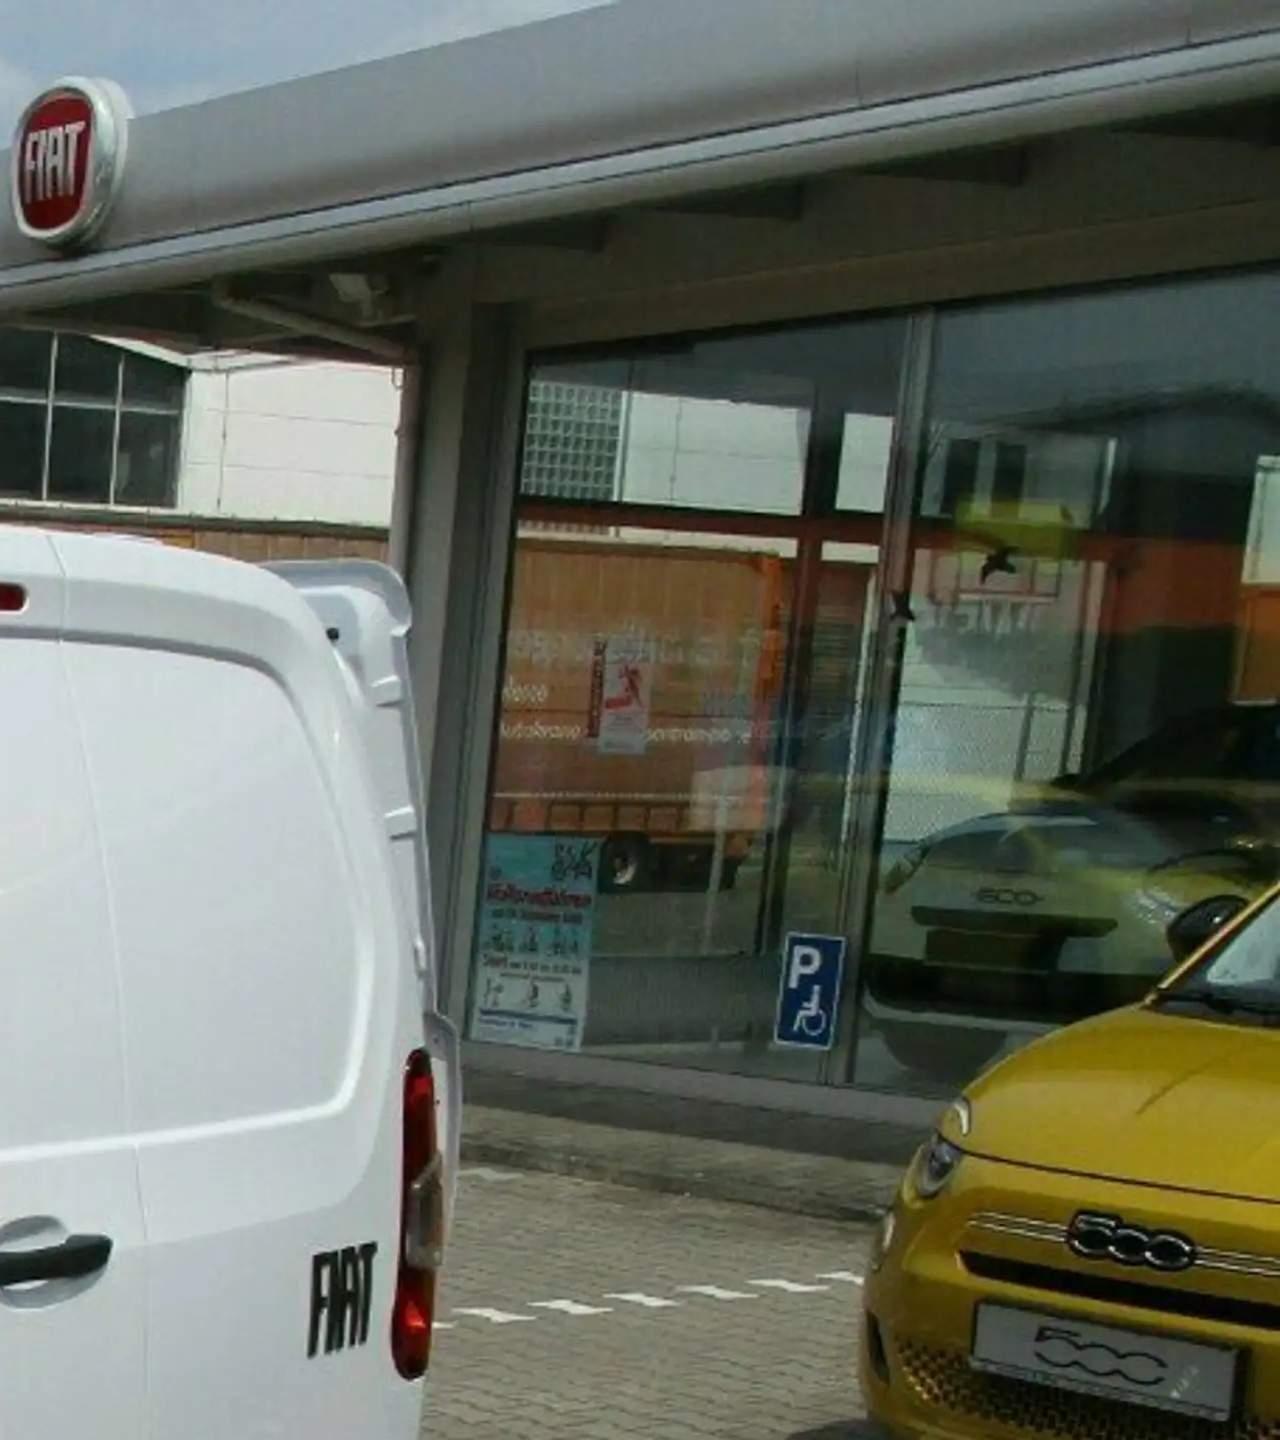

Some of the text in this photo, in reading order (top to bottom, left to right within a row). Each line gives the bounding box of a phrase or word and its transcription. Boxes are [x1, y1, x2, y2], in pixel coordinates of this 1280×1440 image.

[24, 120, 87, 205] FIAT
[788, 945, 821, 989] P
[307, 1241, 379, 1361] FIAT
